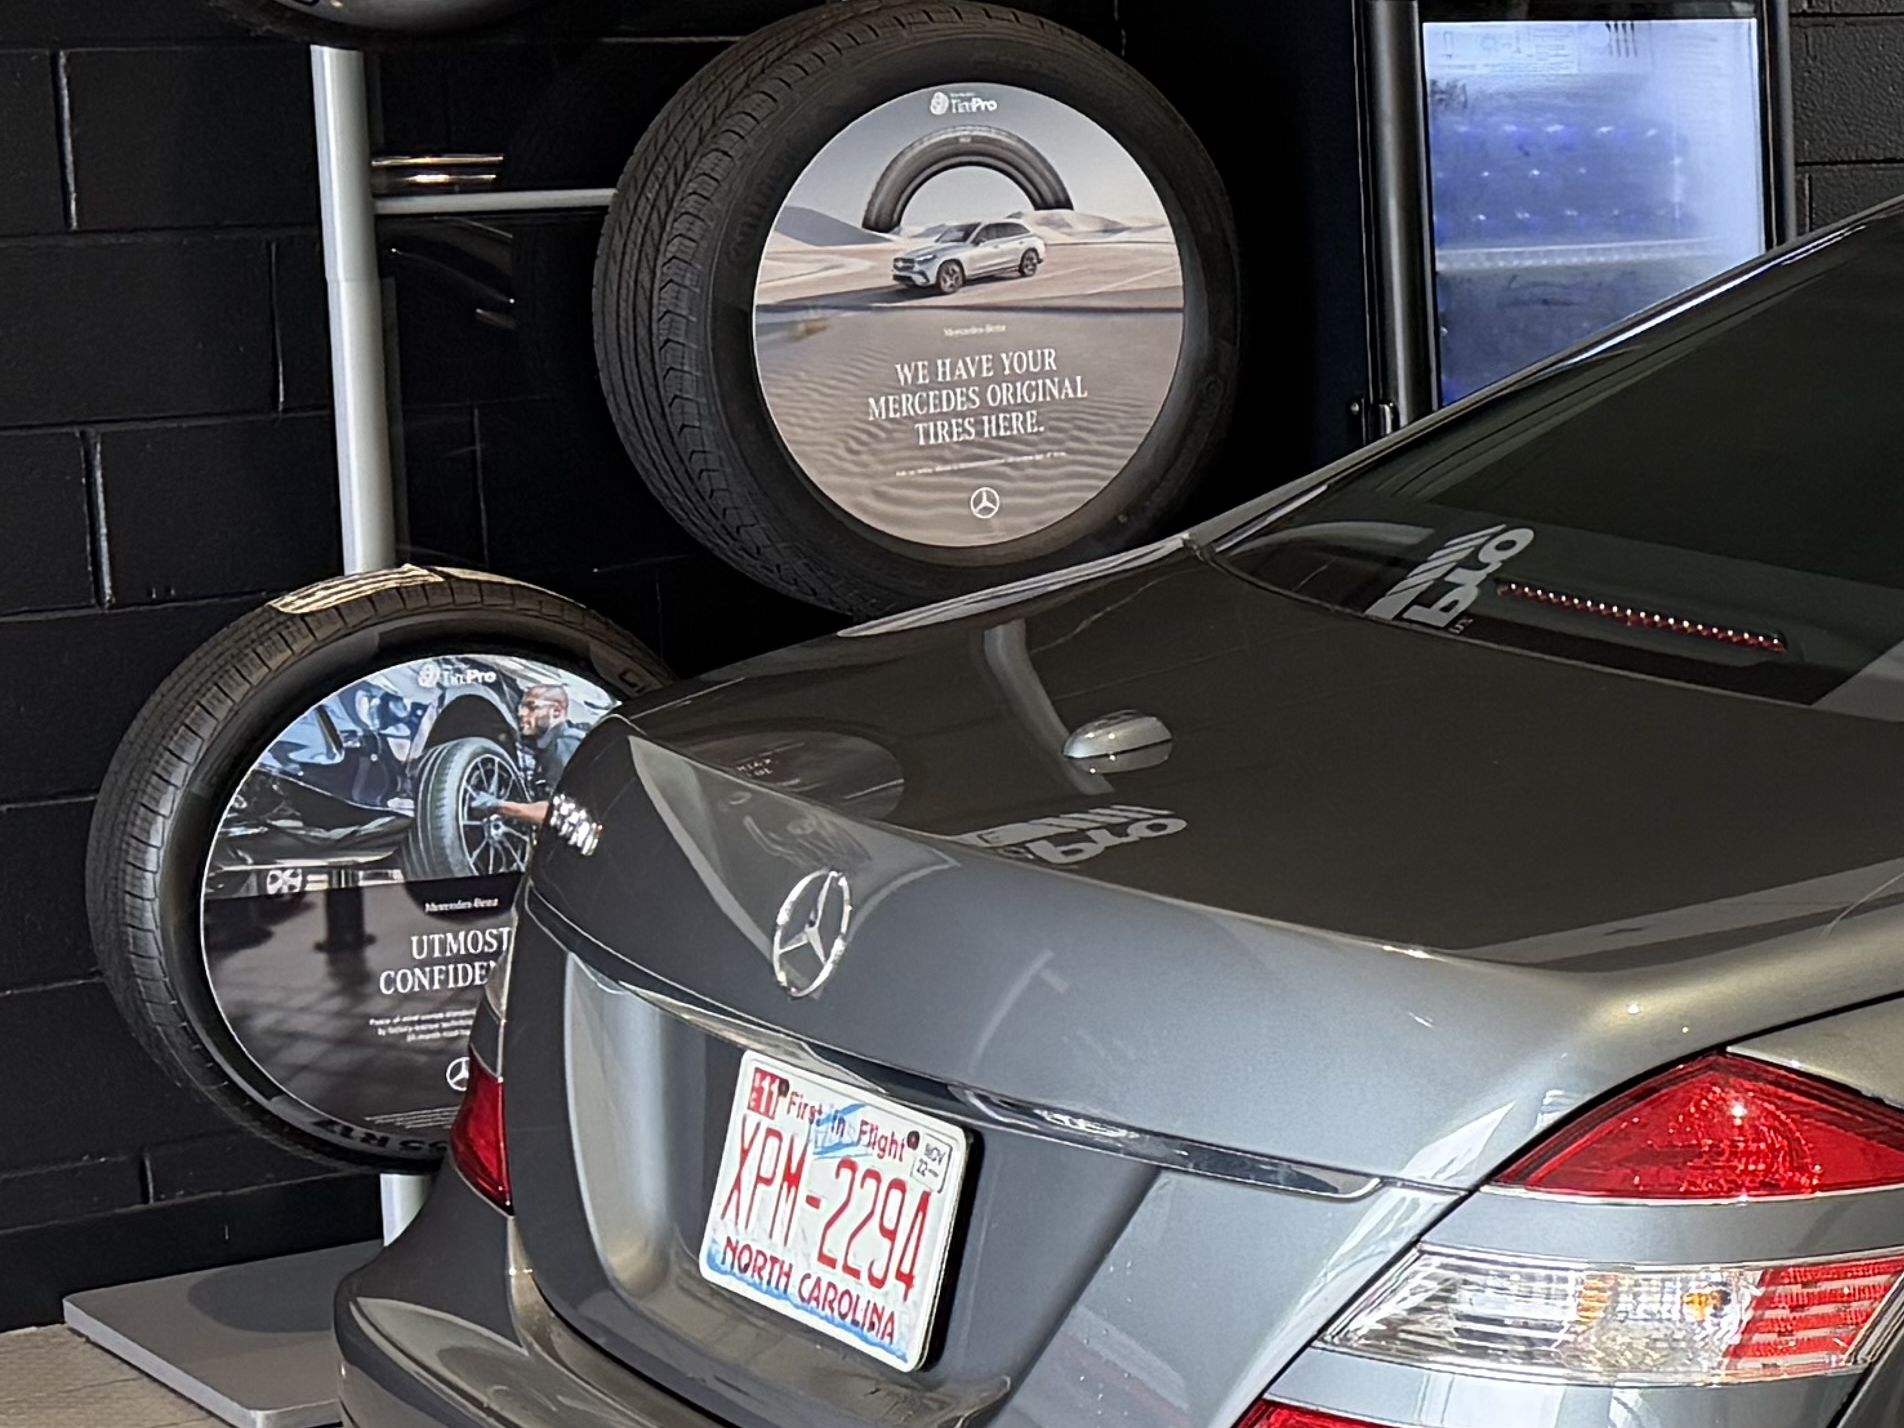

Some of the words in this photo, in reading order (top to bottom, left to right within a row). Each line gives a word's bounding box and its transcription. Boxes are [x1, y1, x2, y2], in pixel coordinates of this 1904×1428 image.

[894, 360, 930, 388] WE
[936, 354, 994, 383] HAVE
[999, 348, 1057, 375] YOUR
[867, 385, 980, 421] MERCEDES
[986, 375, 1088, 408] ORIGINAL
[914, 417, 976, 446] TIRES
[981, 409, 1046, 439] HERE.
[410, 926, 513, 960] UTMOST
[379, 959, 497, 995] CONFIDE
[786, 1091, 823, 1128] First
[829, 1103, 846, 1138] in
[856, 1119, 907, 1164] Flight
[720, 1112, 933, 1304] XPM-2294
[720, 1235, 794, 1296] NORTH
[797, 1272, 897, 1346] CAROLINA
